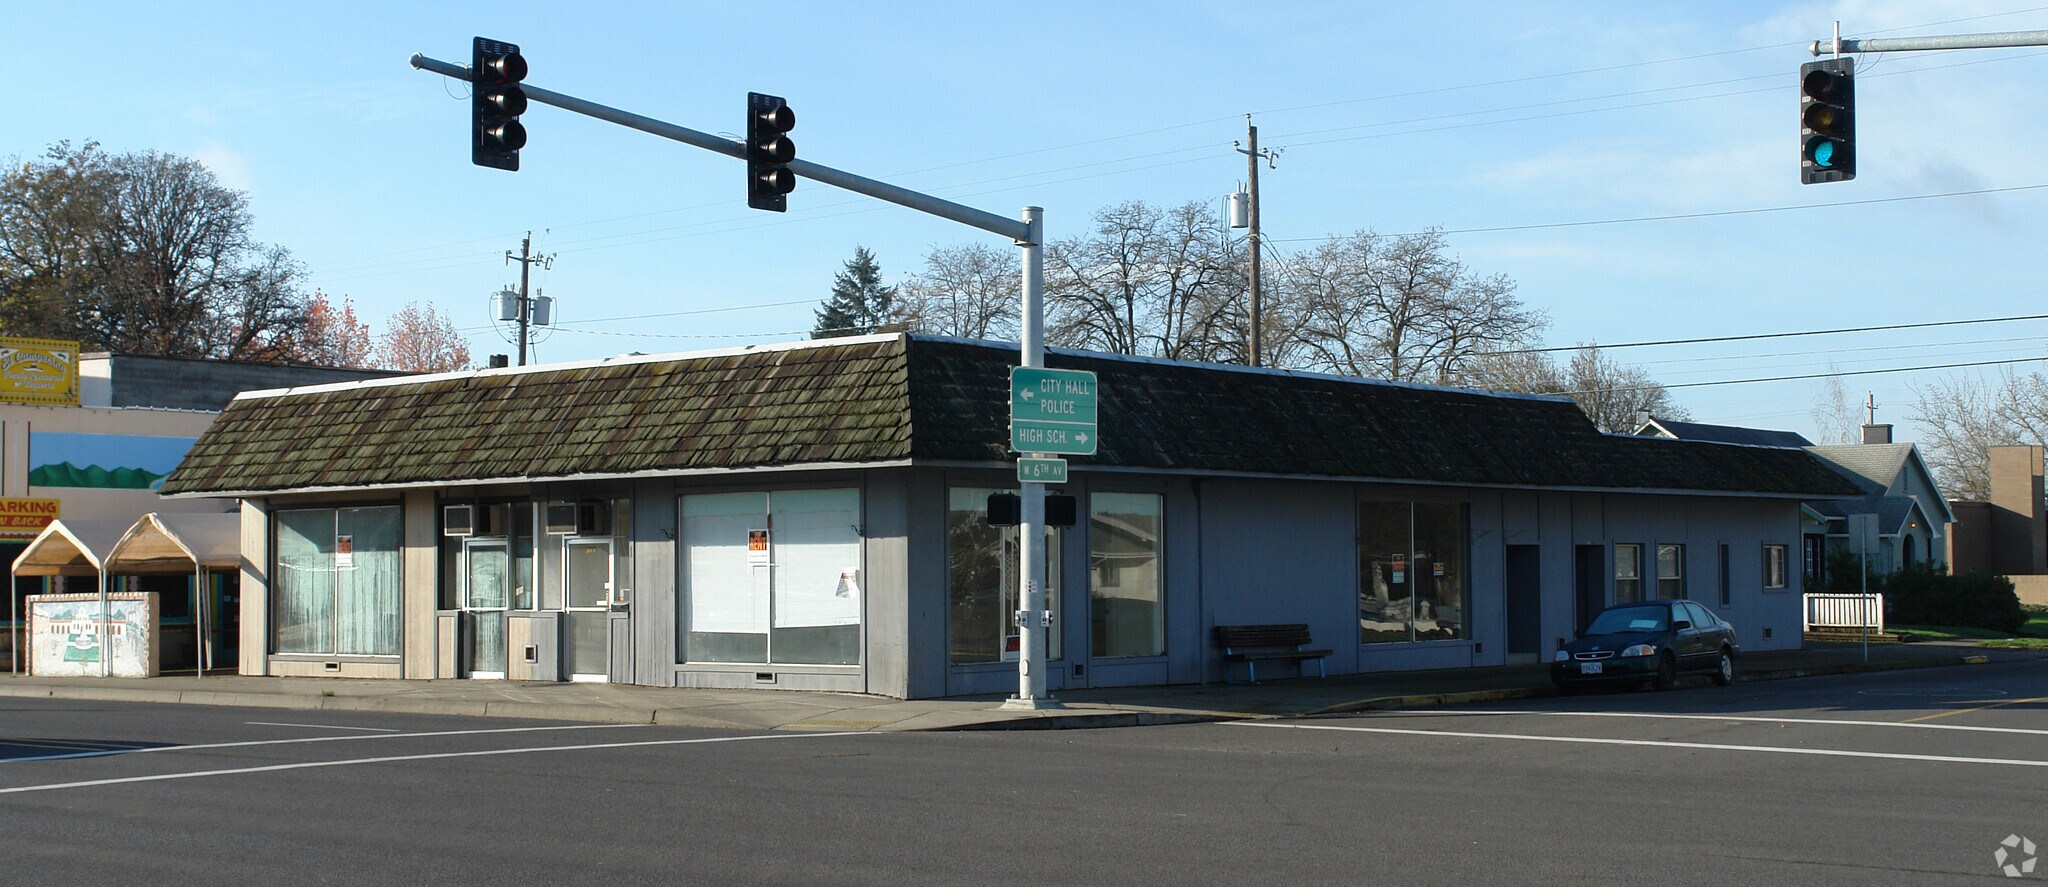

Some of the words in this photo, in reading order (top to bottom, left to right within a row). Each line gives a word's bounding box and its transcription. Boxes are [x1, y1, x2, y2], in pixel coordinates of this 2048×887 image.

[1, 354, 14, 371] El
[1040, 379, 1061, 393] CITY
[1065, 381, 1090, 395] HALL
[1040, 399, 1075, 414] POLICE
[1020, 428, 1043, 442] HIGH
[1046, 429, 1068, 444] SCH.
[1024, 465, 1030, 475] W
[1033, 463, 1049, 477] 6TH
[1053, 466, 1063, 475] AV
[11, 517, 42, 526] BACK
